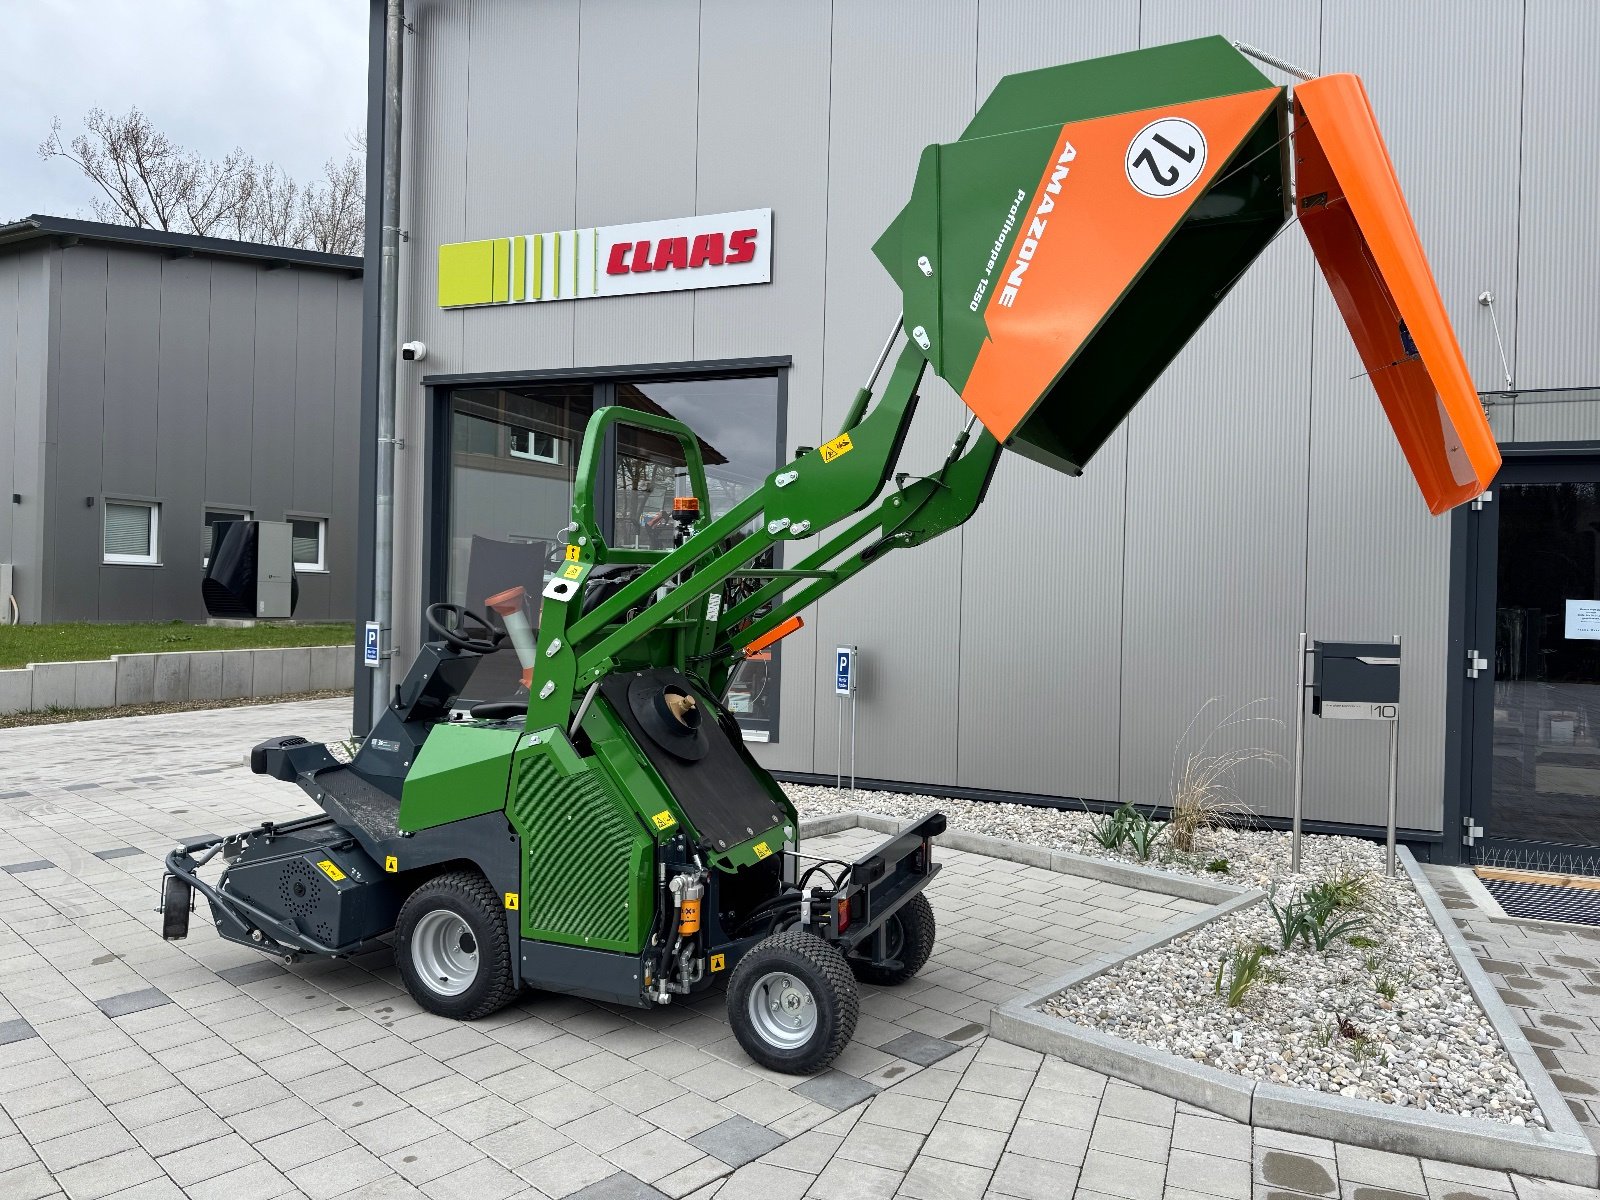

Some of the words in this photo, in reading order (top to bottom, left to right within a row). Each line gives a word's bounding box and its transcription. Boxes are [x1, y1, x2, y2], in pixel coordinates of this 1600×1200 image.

[1132, 132, 1196, 187] 12
[984, 188, 1026, 277] Profihopper
[998, 140, 1077, 308] AMAZONE
[607, 229, 758, 275] CLAAS
[969, 278, 989, 312] 1250
[368, 631, 376, 645] P
[839, 656, 848, 672] P
[1373, 705, 1397, 718] 10
